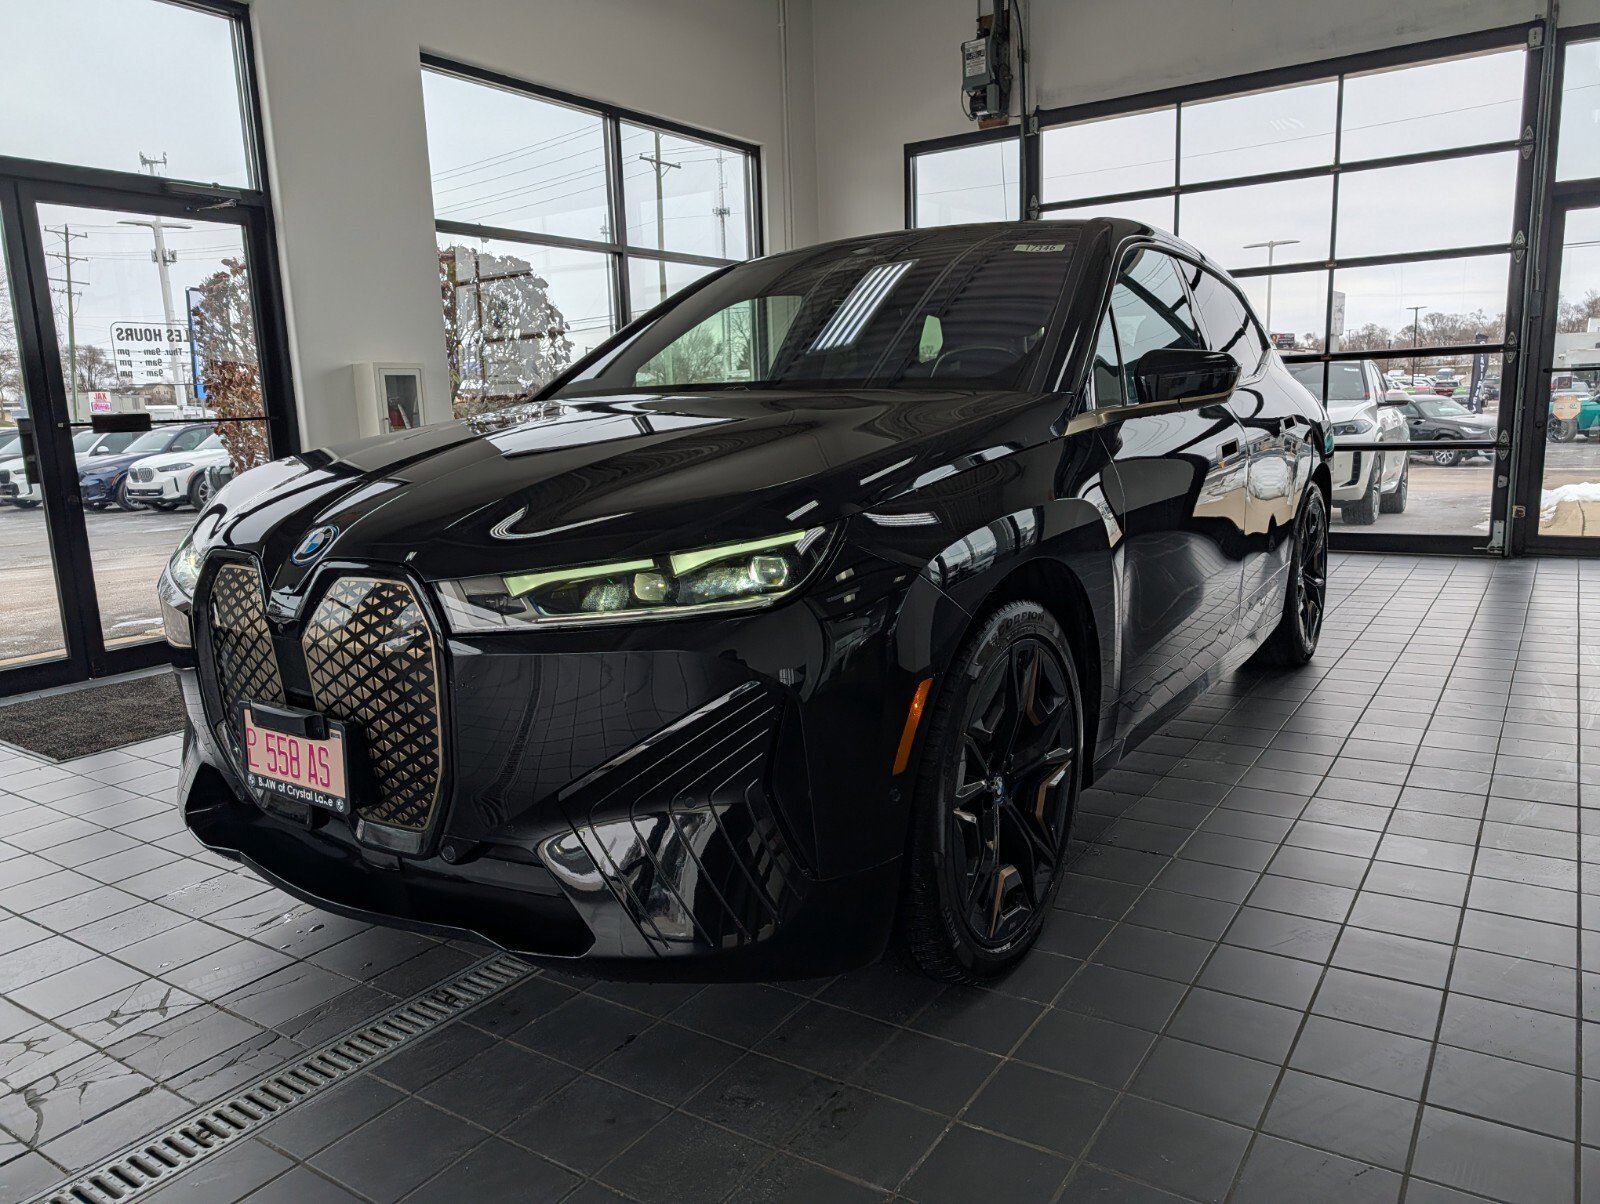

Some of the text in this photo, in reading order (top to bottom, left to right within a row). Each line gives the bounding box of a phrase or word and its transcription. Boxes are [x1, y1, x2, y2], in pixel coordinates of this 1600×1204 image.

[265, 733, 300, 778] 558
[308, 743, 331, 788] AS
[278, 783, 286, 793] of
[287, 785, 313, 802] Crystal
